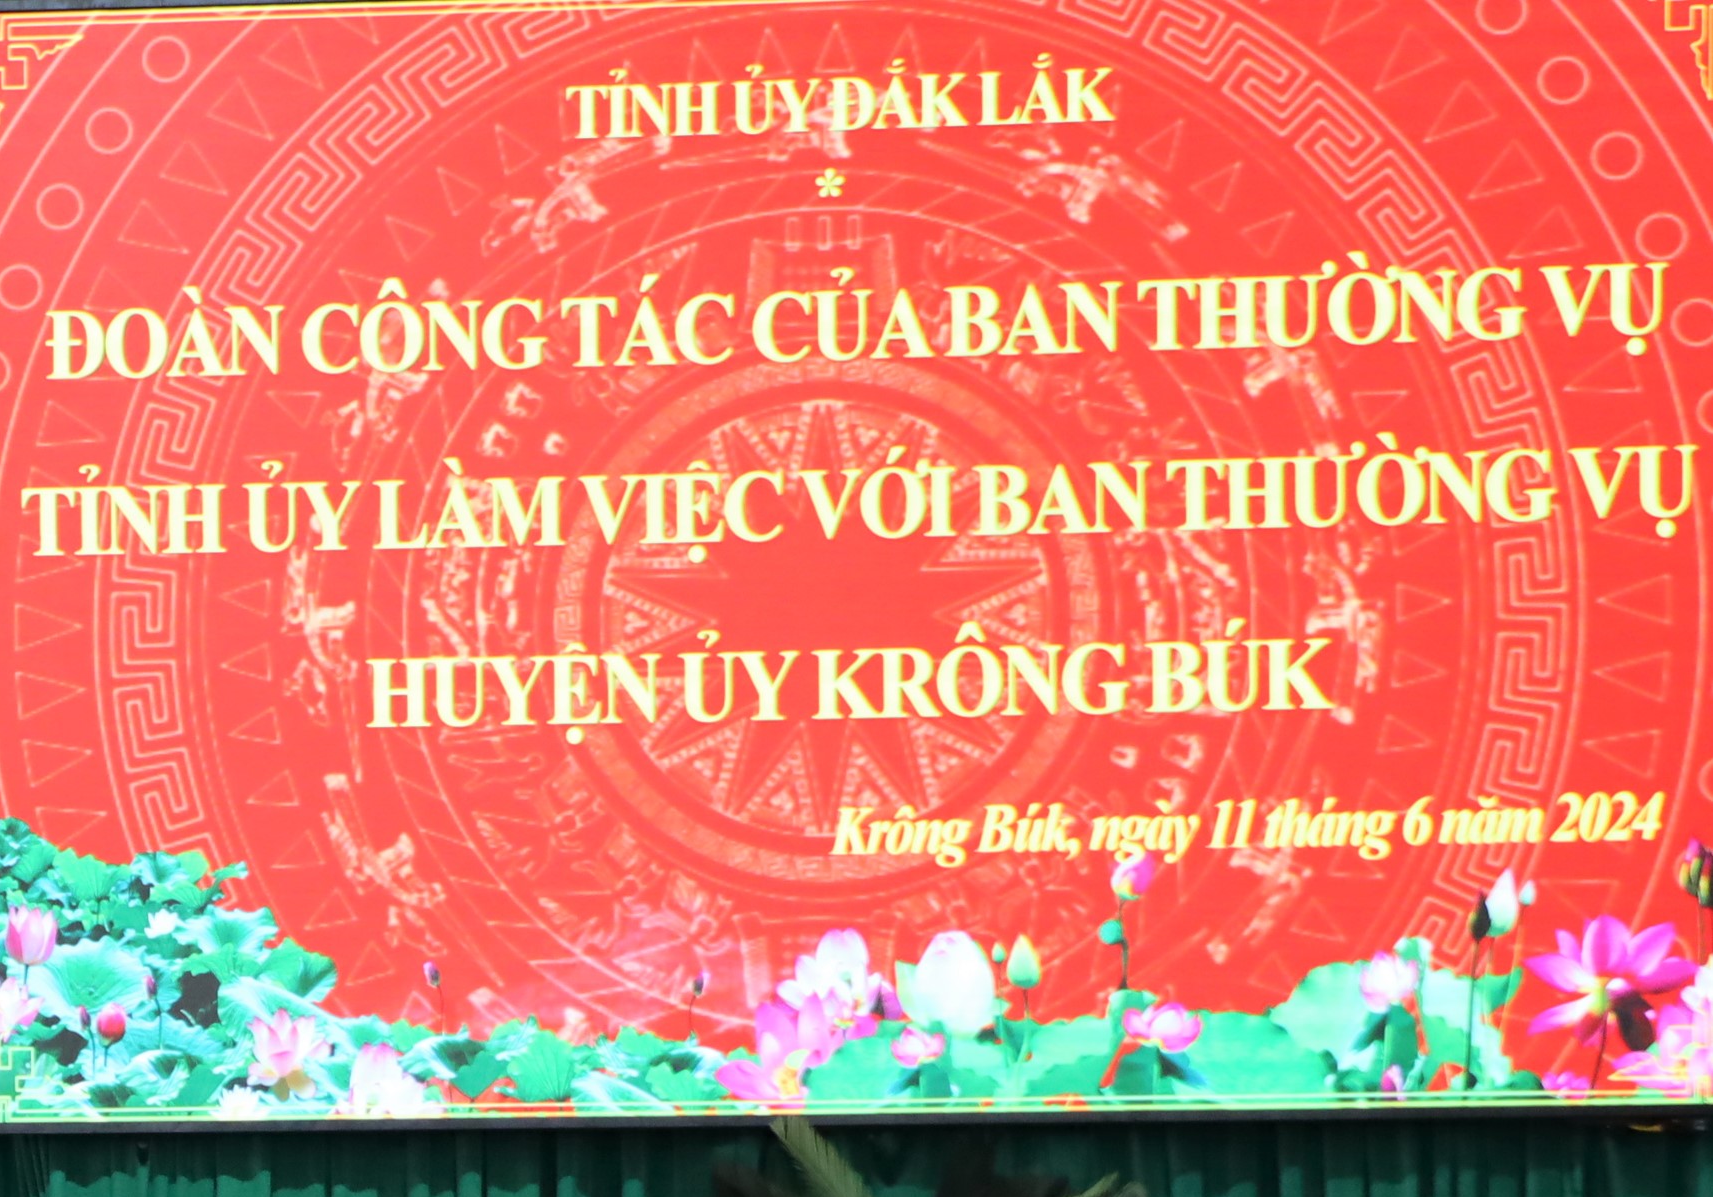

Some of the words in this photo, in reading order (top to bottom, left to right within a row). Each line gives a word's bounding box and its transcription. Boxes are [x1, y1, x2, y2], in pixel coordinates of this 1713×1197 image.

[566, 68, 725, 139] TỈNH
[734, 65, 821, 136] ỦY
[828, 58, 968, 132] ĐẮK
[977, 52, 1116, 127] LẮK
[46, 285, 281, 380] ĐOÀN
[300, 277, 549, 374] CÔNG
[562, 274, 734, 368] TÁC
[751, 267, 931, 364] CỦA
[945, 281, 1120, 357] BAN
[1138, 250, 1527, 351] THƯỜNG
[1540, 262, 1670, 356] VỤ
[22, 464, 226, 557] TỈNH
[243, 460, 362, 553] ỦY
[373, 457, 565, 550] LÀM
[579, 461, 786, 564] VIỆC
[800, 445, 957, 541] VỚI
[973, 460, 1150, 537] BAN
[1168, 432, 1556, 532] THƯỜNG
[1568, 444, 1697, 538] VỤ
[366, 642, 660, 744] HUYỆN
[677, 629, 798, 722] ỦY
[812, 620, 1130, 721] KRÔNG
[1146, 618, 1334, 714] BÚK
[832, 806, 971, 867] Krông
[978, 803, 1084, 859] Búk,
[1089, 798, 1202, 863] ngày
[1207, 799, 1254, 850] 11
[1265, 796, 1396, 860] tháng
[1403, 797, 1433, 848] 6
[1438, 795, 1544, 845] năm
[1551, 791, 1665, 843] 2024
